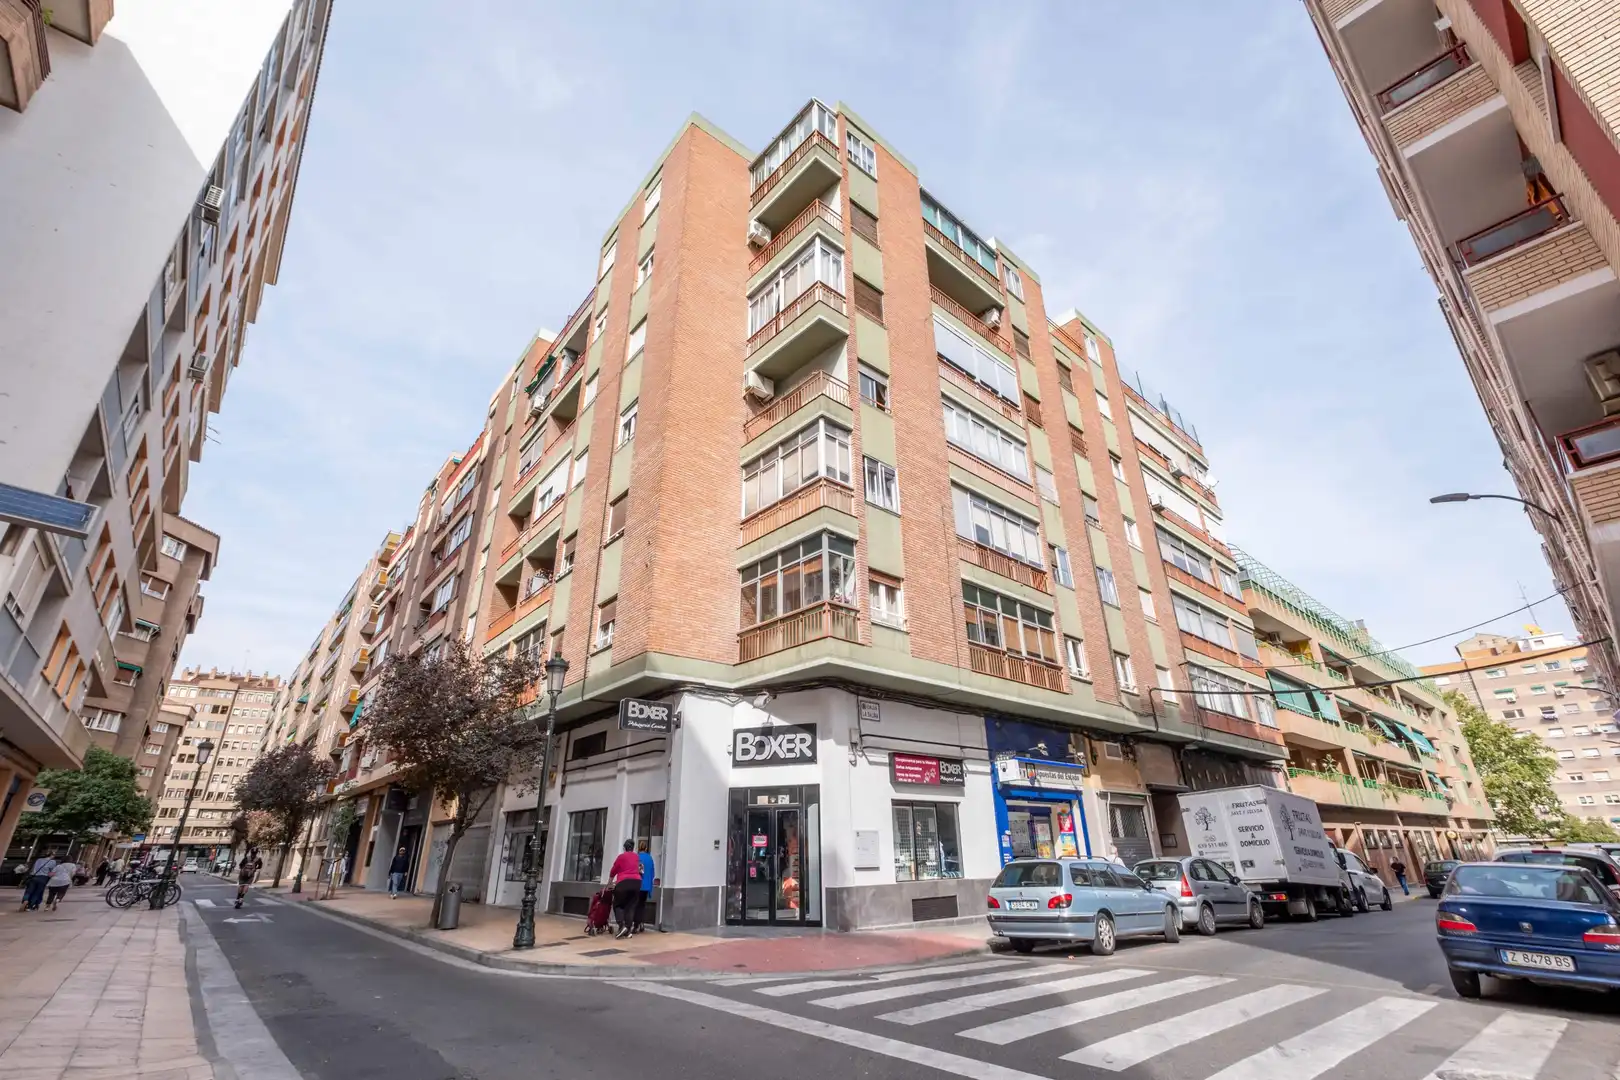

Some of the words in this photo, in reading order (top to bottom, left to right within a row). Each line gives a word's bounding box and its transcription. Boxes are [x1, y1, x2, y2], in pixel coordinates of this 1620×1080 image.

[628, 701, 669, 720] BOXER
[736, 732, 813, 761] BOXER
[940, 761, 961, 774] BOXER
[1240, 839, 1270, 847] DOMICILIO
[1511, 952, 1518, 962] Z
[1523, 954, 1552, 965] 8478
[1556, 956, 1571, 968] BS
